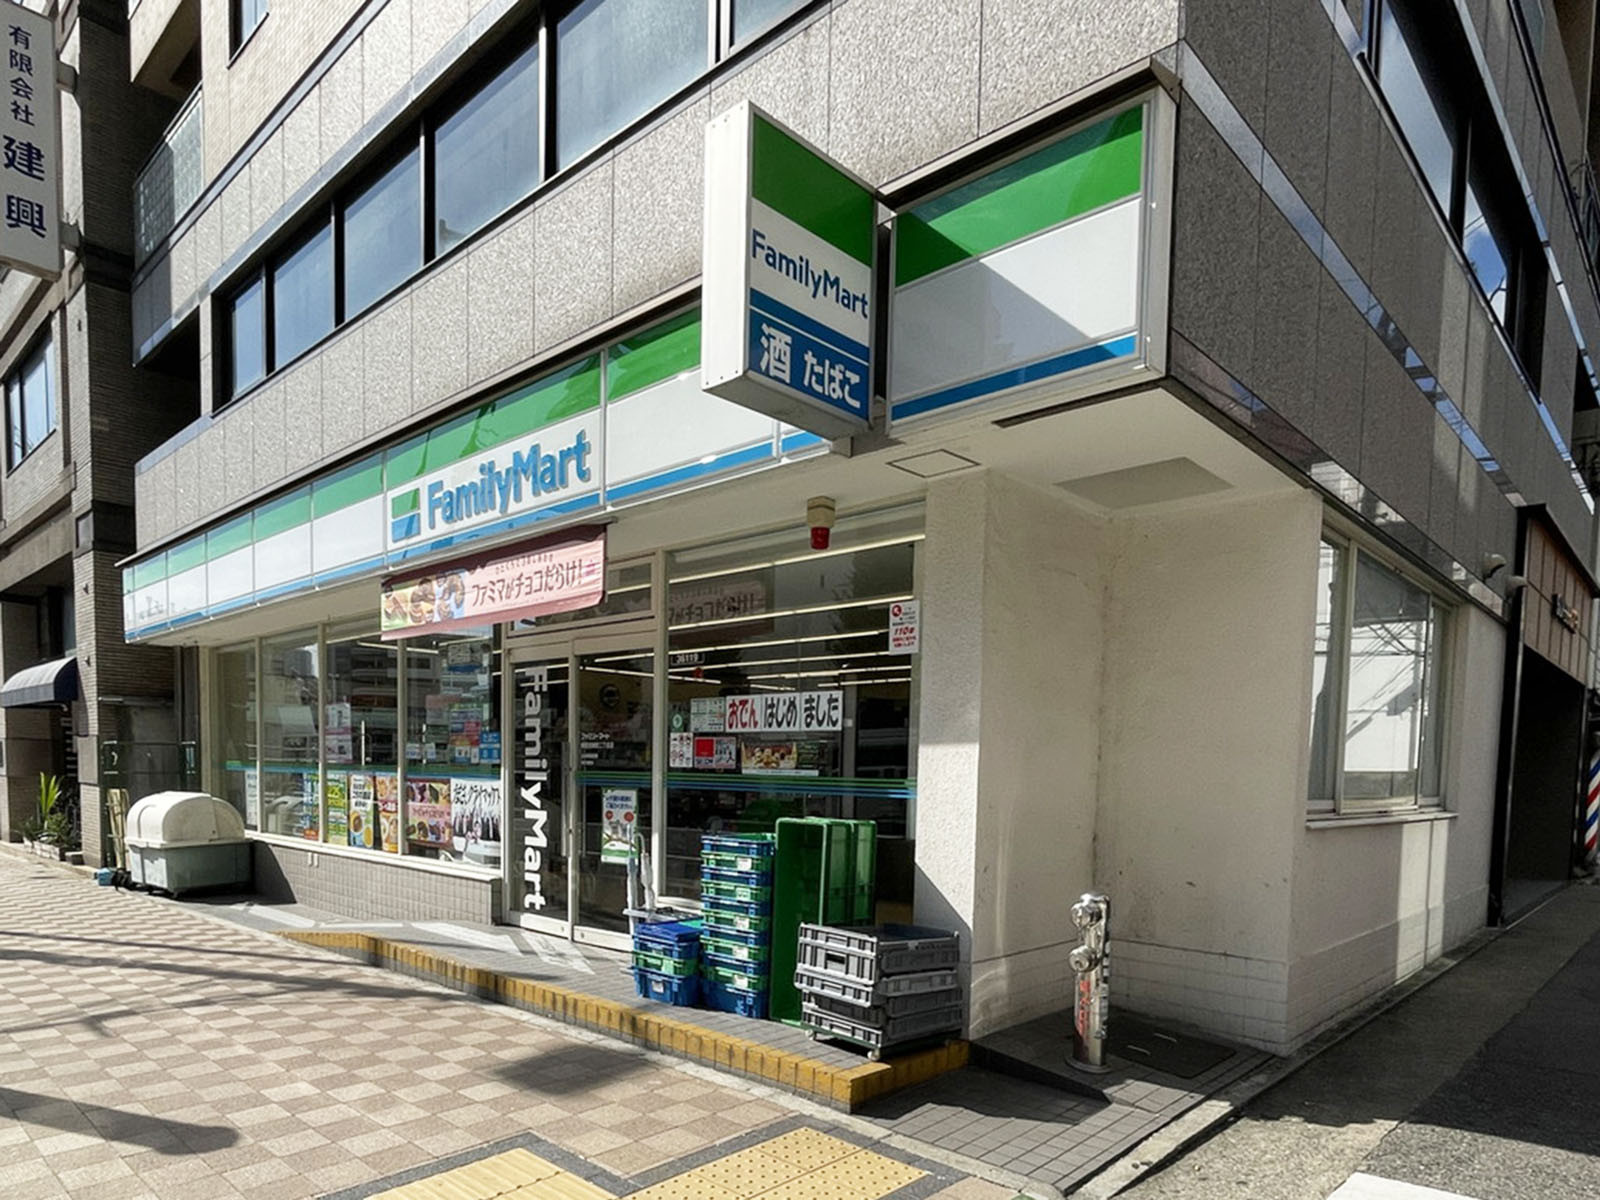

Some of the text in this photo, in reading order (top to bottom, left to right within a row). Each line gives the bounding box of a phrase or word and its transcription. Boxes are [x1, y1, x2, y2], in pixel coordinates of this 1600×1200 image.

[3, 25, 46, 239] 有限会社 建興
[752, 228, 869, 319] FamilyMart
[759, 322, 862, 409] 酒 たばこ
[427, 428, 592, 530] FamilyMart
[520, 665, 548, 911] FamilyMart
